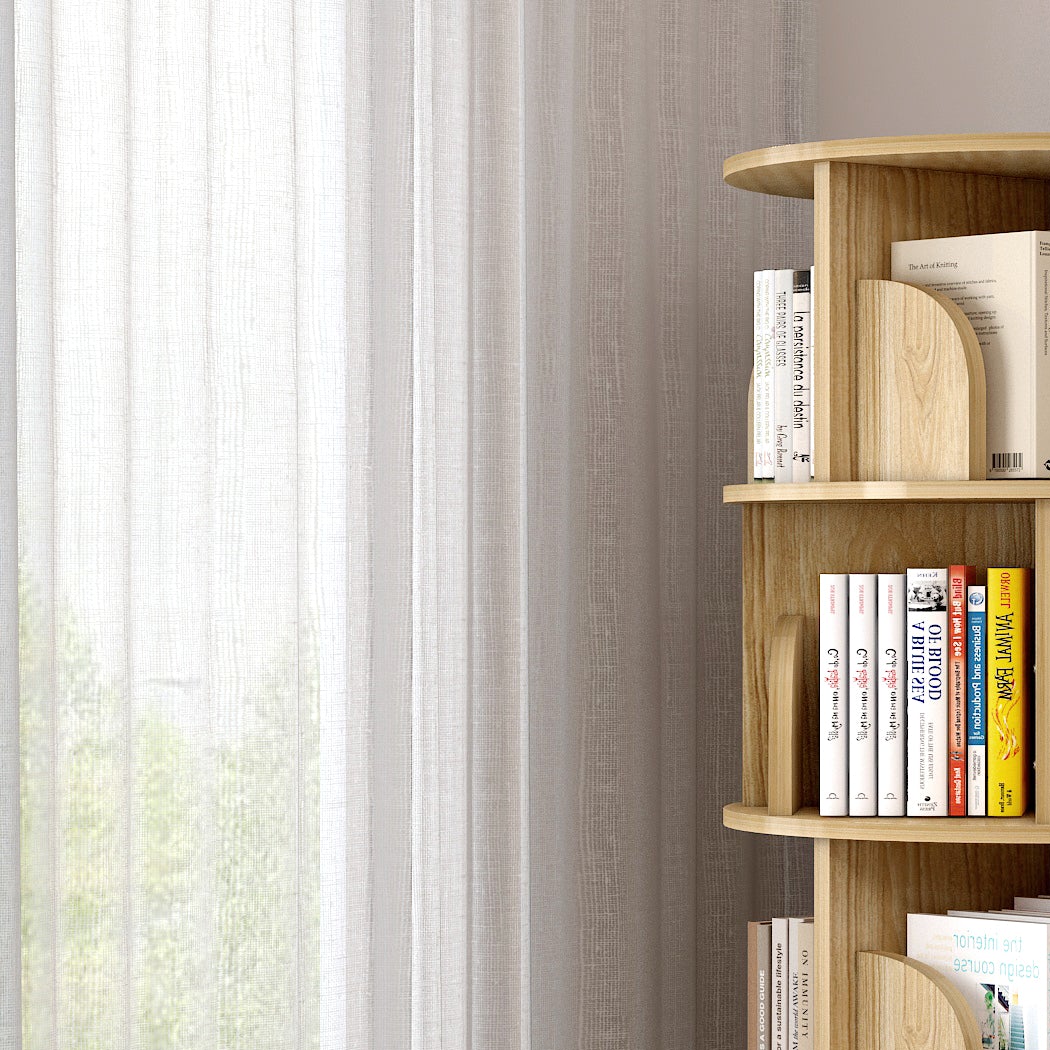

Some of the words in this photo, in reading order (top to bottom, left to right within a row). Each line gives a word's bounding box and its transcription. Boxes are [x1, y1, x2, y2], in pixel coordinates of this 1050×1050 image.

[908, 263, 919, 271] The
[919, 262, 929, 270] Art
[936, 260, 958, 270] Knitting
[776, 292, 787, 310] THREE
[776, 312, 787, 329] PAIRS
[776, 331, 787, 339] OF
[776, 341, 787, 367] GLASSES
[794, 384, 810, 397] du
[794, 401, 810, 429] destin
[802, 950, 809, 966] ON
[759, 1034, 765, 1042] A
